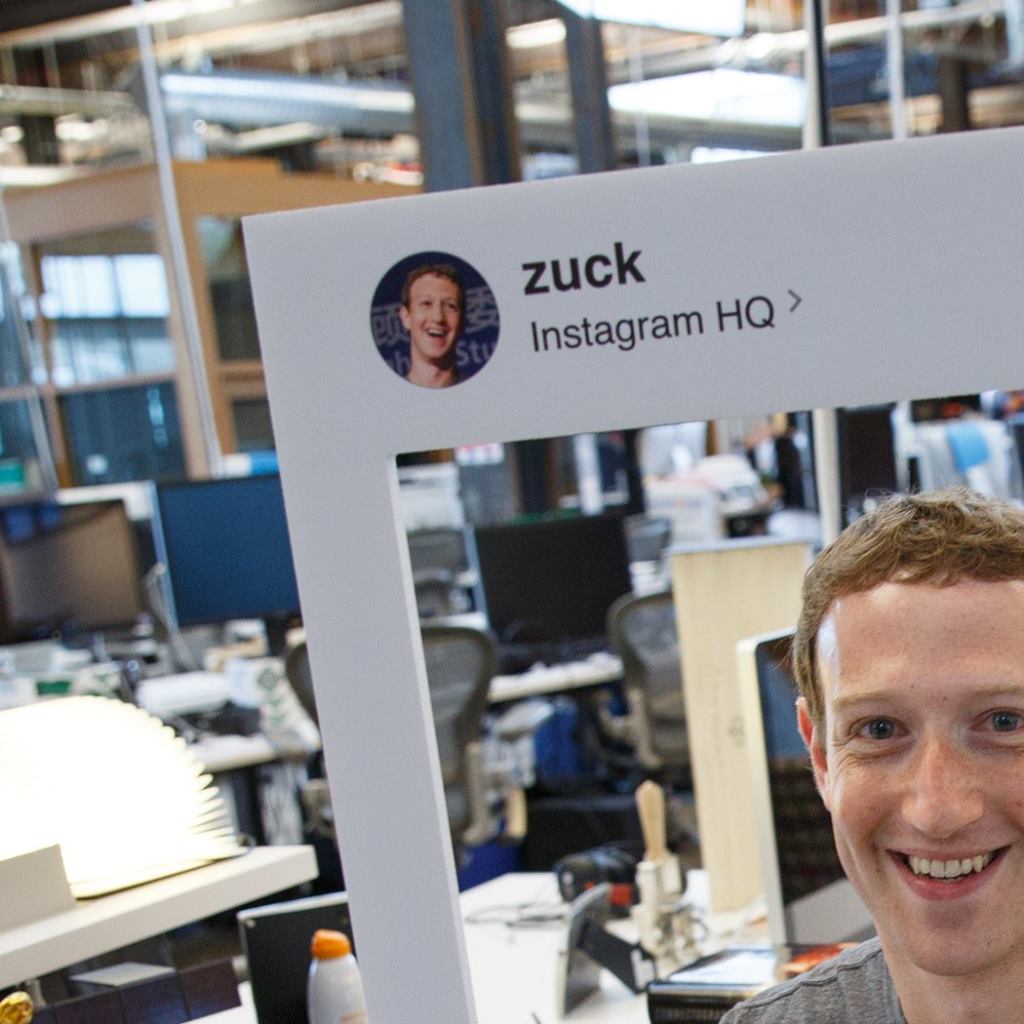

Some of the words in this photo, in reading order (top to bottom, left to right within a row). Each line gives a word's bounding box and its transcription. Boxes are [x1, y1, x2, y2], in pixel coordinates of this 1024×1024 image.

[521, 241, 647, 296] zuck
[530, 310, 705, 353] Instagram
[715, 295, 776, 333] HQ
